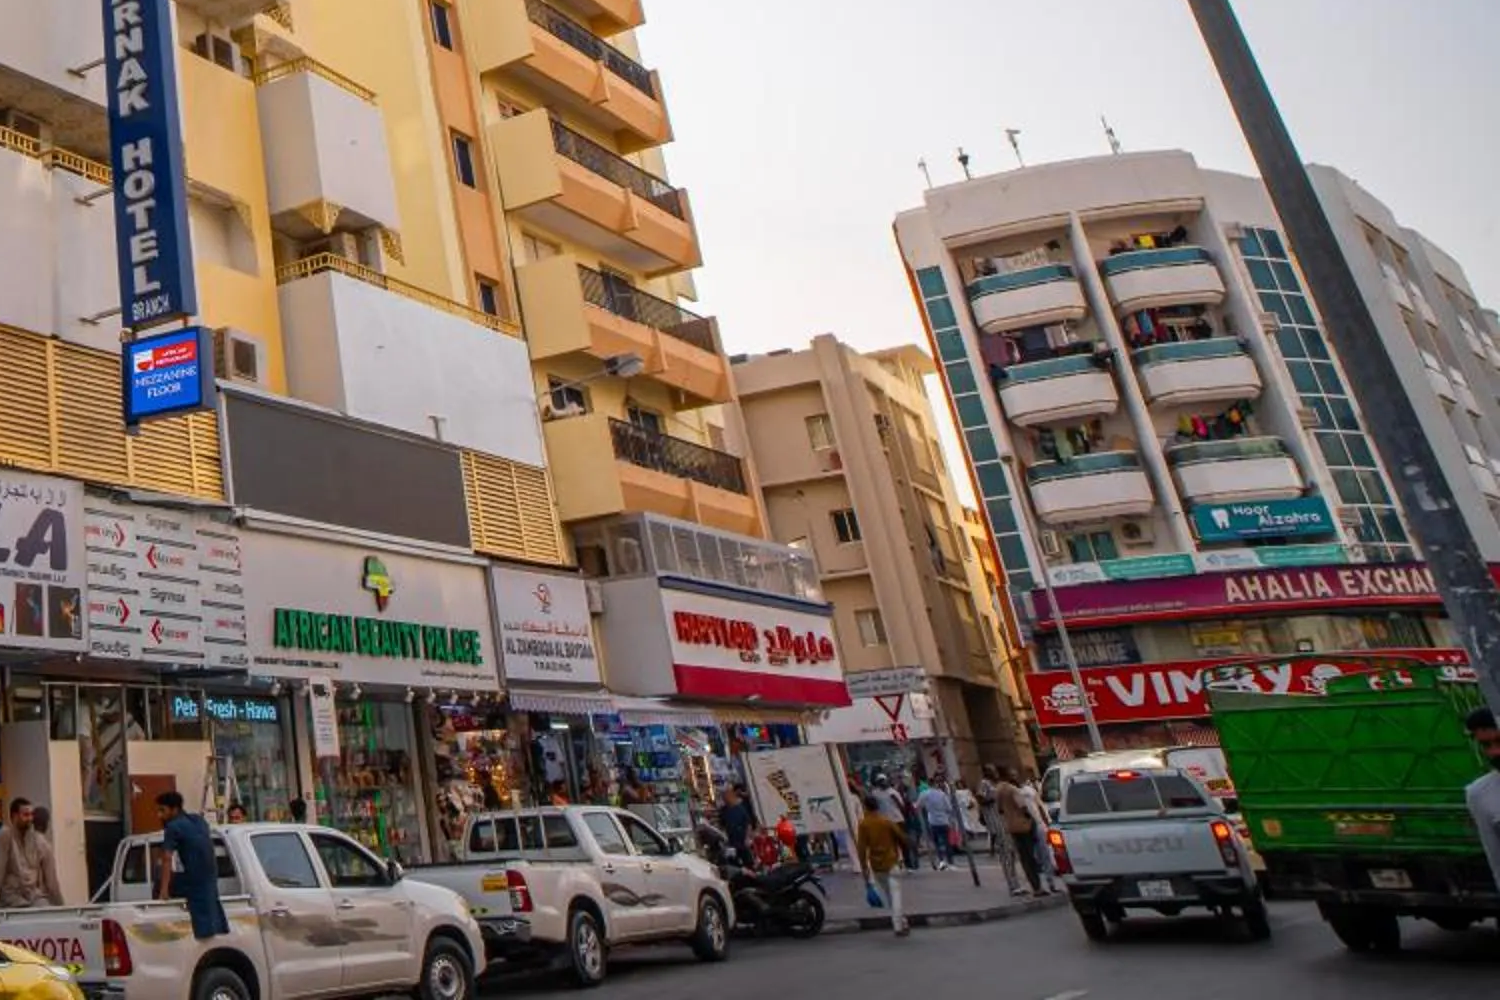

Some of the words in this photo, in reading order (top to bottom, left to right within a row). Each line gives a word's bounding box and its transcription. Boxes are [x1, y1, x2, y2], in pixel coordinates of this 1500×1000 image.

[121, 137, 160, 294] HOTEL
[132, 293, 171, 321] BRANCH
[147, 382, 181, 398] FLOOR
[1224, 572, 1333, 603] AHALIA
[1338, 565, 1437, 596] EXCHA
[274, 607, 354, 653] AFRICAN
[354, 616, 421, 659] BEAUTY
[421, 624, 484, 667] PALACE
[1050, 643, 1130, 667] EXHANGE
[1105, 663, 1292, 707] VIMY
[1097, 835, 1185, 855] ISUZU
